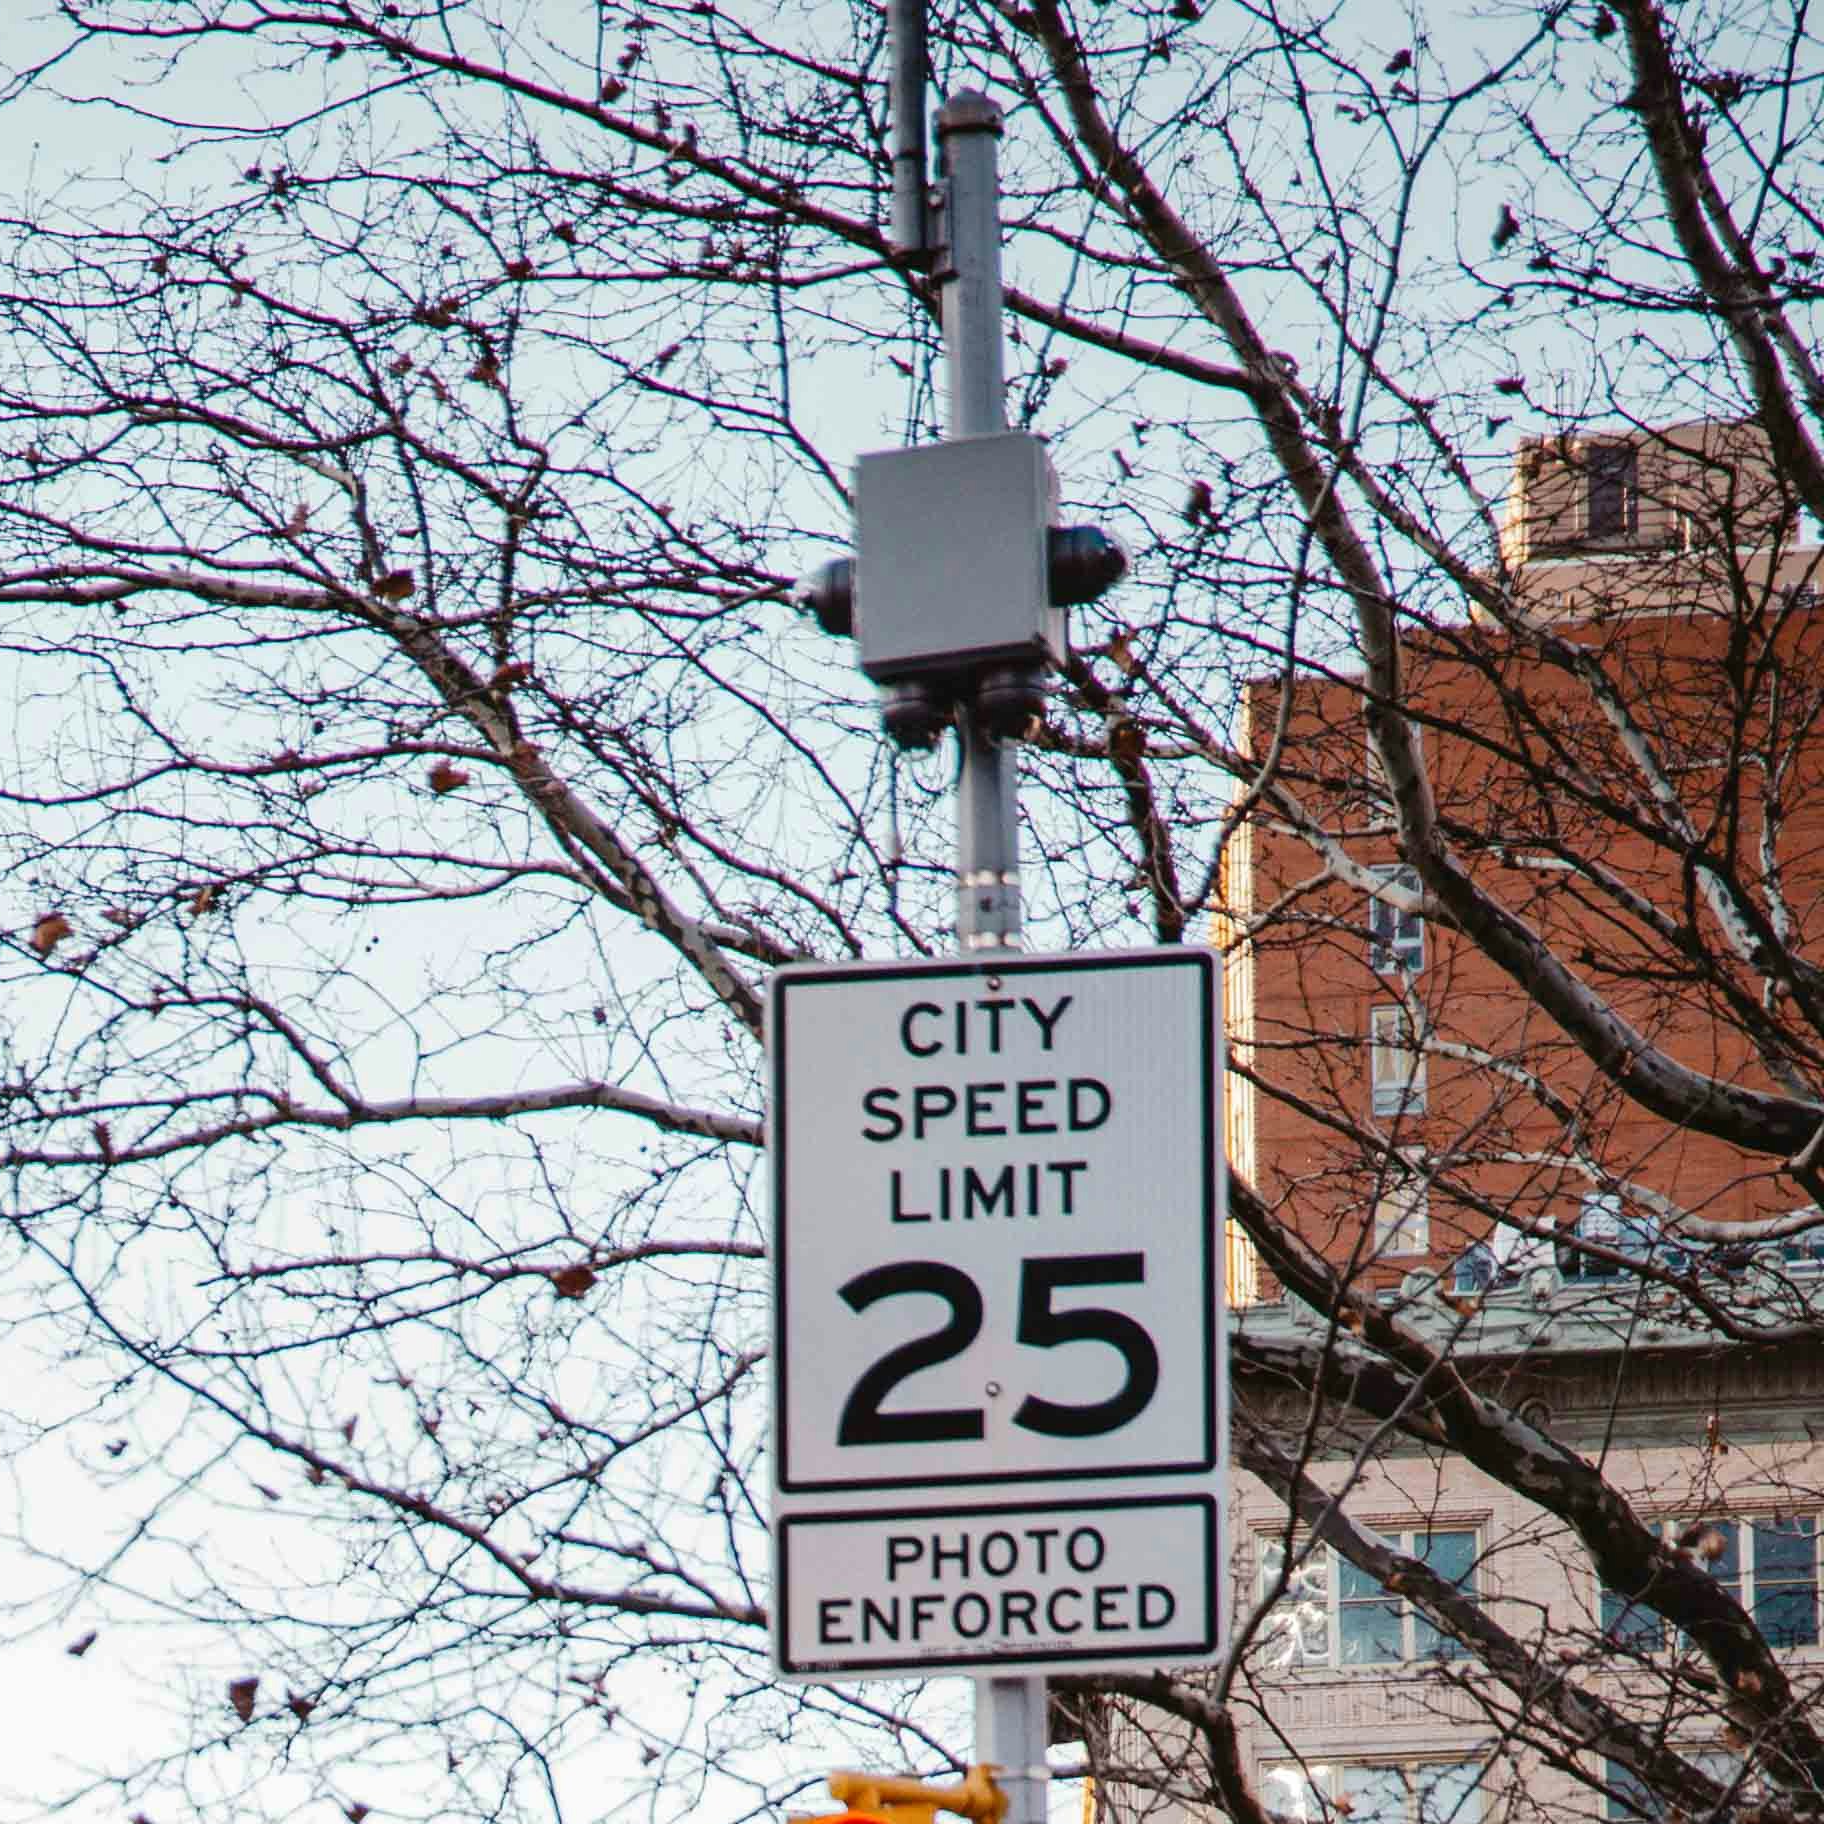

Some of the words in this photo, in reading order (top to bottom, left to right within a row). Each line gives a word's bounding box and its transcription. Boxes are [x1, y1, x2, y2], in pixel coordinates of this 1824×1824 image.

[900, 996, 1074, 1056] CITY
[862, 1077, 1111, 1143] SPEED
[890, 1161, 1087, 1224] LIMIT
[836, 1251, 1159, 1448] 25
[886, 1527, 1105, 1581] PHOTO
[818, 1584, 1176, 1645] ENFORCED
